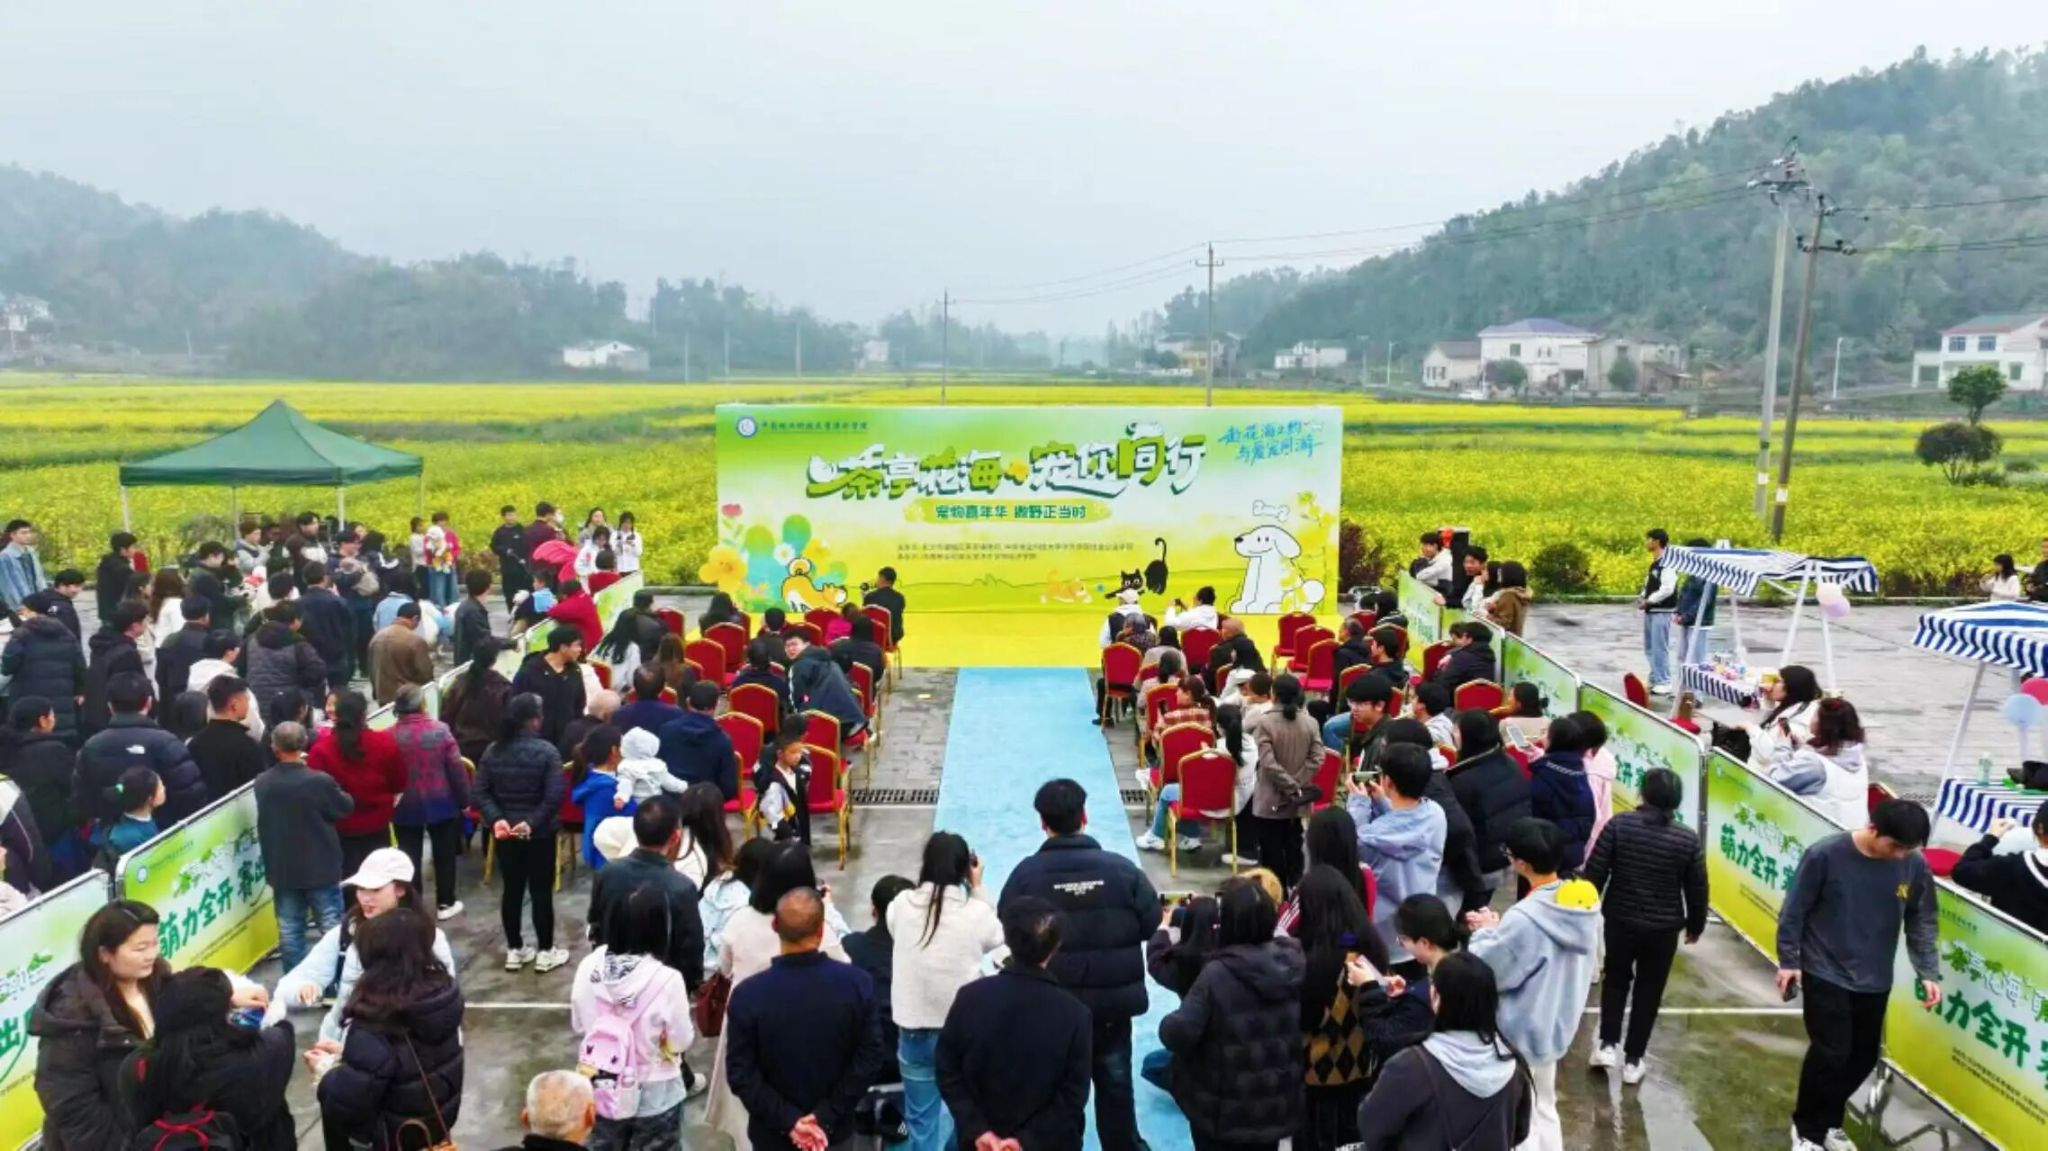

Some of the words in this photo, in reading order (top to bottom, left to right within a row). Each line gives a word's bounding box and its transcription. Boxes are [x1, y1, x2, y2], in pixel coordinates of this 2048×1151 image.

[1720, 823, 1779, 890] 萌力全开
[158, 876, 234, 960] 萌力全开
